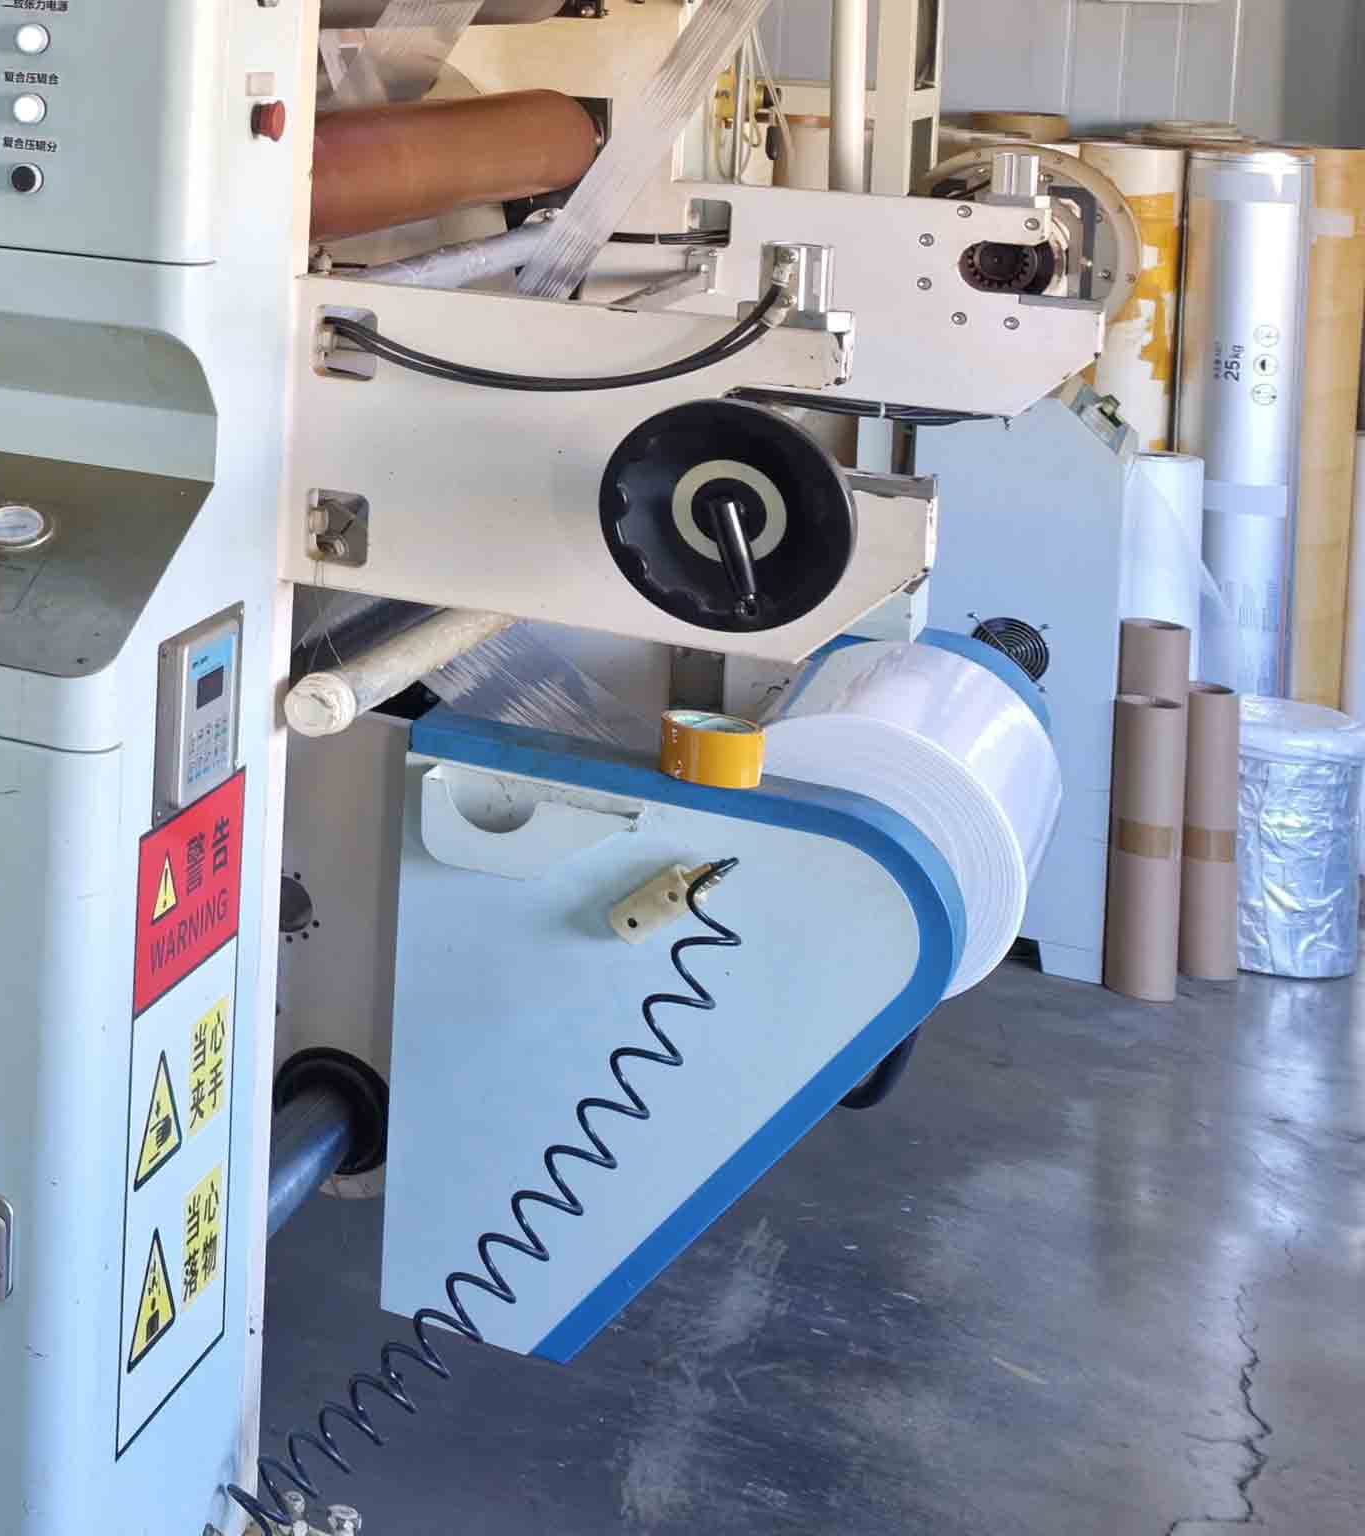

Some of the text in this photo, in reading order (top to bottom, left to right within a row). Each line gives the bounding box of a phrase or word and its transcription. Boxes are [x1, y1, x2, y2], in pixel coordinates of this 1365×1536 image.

[148, 888, 229, 977] WARNING
[192, 1010, 226, 1073] 当心
[189, 1058, 224, 1130] 夹手
[185, 1180, 220, 1247] 当心
[182, 1231, 218, 1304] 落物
